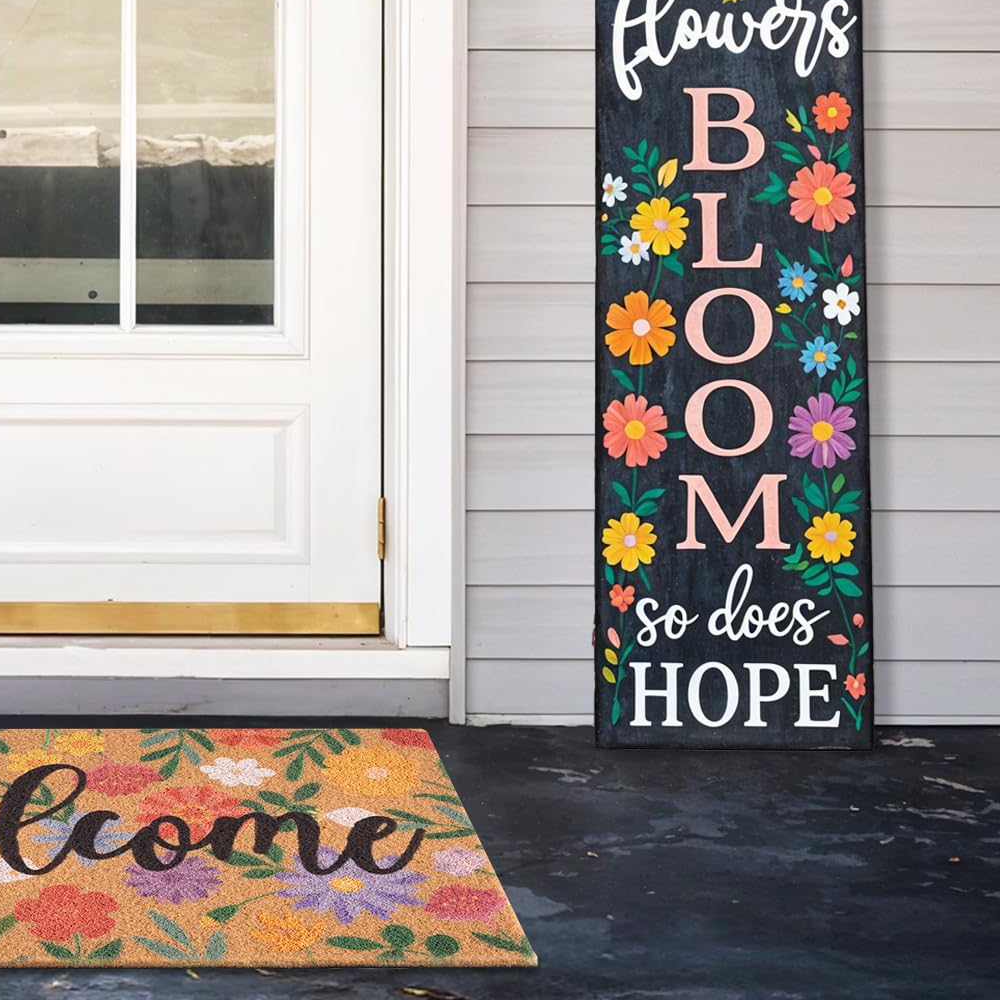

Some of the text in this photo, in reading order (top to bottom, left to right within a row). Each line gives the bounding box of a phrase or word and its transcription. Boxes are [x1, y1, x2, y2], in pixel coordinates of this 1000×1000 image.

[676, 87, 790, 550] BLOOM
[635, 563, 831, 647] so does
[628, 661, 841, 728] HOPE
